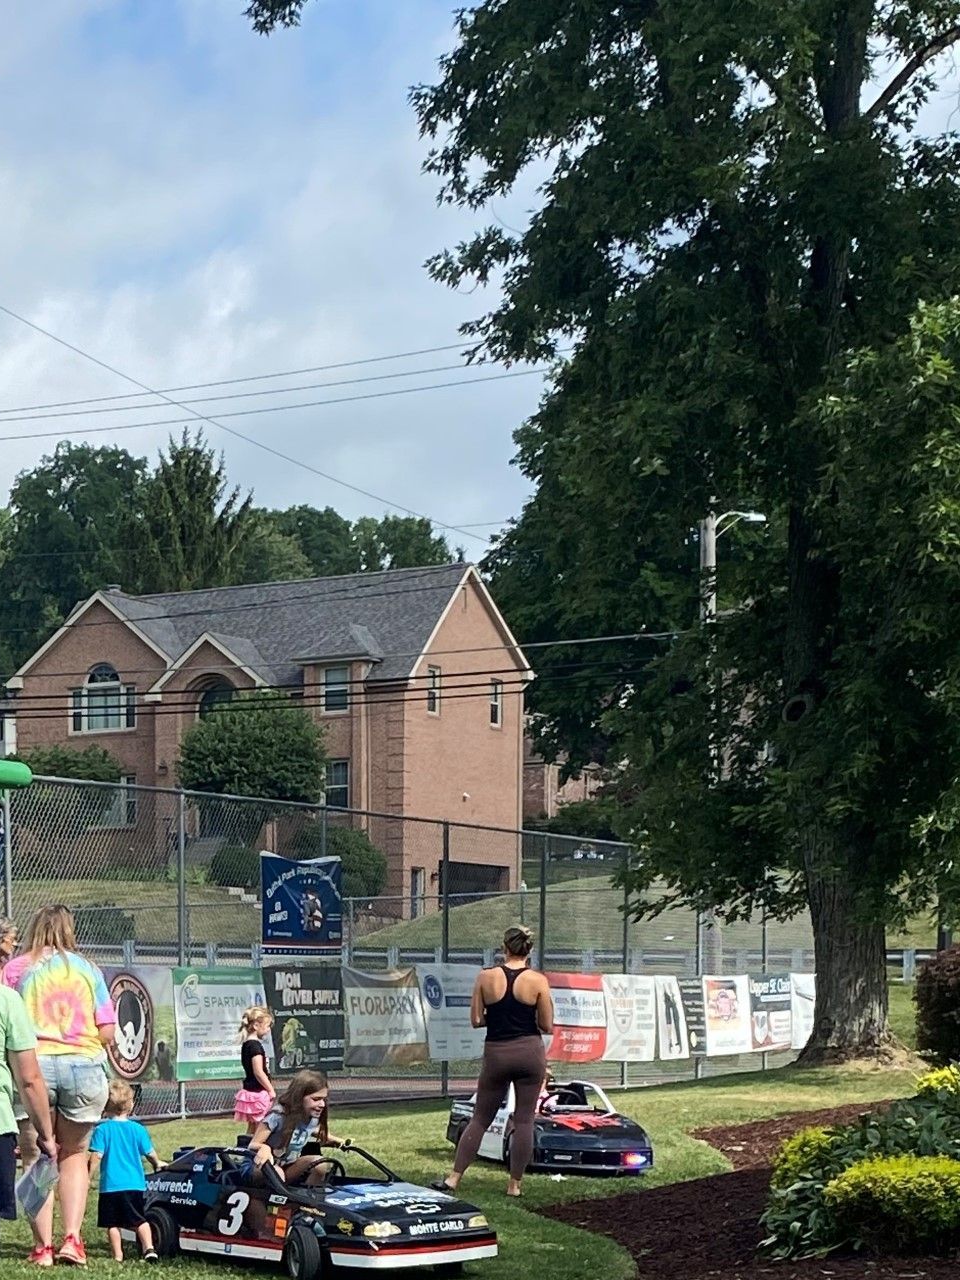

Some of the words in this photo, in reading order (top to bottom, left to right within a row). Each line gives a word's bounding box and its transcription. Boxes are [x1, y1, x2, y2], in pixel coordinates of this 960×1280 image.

[275, 971, 302, 991] MON
[203, 996, 247, 1008] SPARTAN
[282, 988, 313, 1008] RIVER
[313, 989, 340, 1006] SUPPLY
[350, 995, 418, 1016] FLORAPARK
[170, 1195, 197, 1206] Service
[218, 1191, 250, 1236] 3
[409, 1221, 439, 1236] MONTE
[439, 1220, 465, 1233] CARLO
